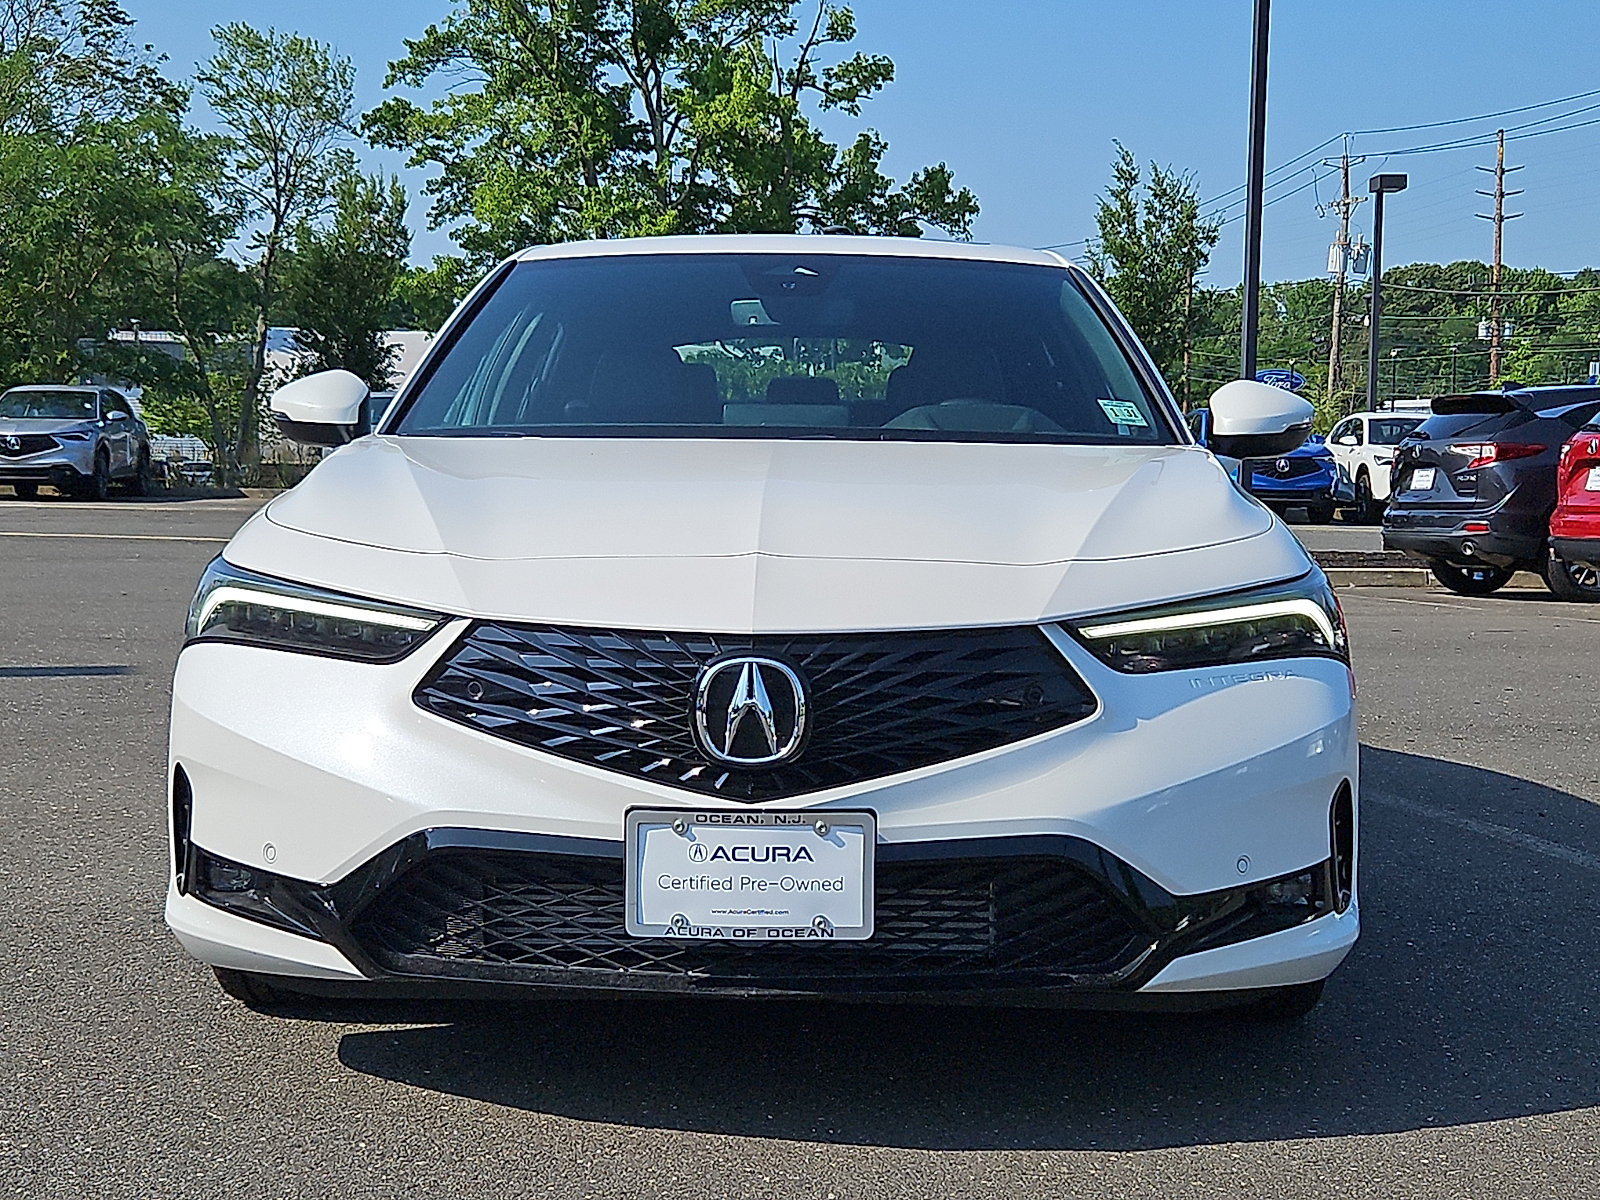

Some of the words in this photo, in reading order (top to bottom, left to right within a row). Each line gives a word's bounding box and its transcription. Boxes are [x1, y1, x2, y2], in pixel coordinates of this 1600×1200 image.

[1189, 669, 1298, 688] INTEGRA
[774, 814, 806, 824] N.J.
[709, 845, 814, 863] ACURA
[657, 874, 733, 891] Certified
[740, 876, 844, 892] Pre-Owned
[710, 908, 790, 916] www.AcuraCertified.com
[664, 926, 725, 938] ACURA
[732, 928, 757, 939] OF
[767, 927, 835, 939] OCEAN
